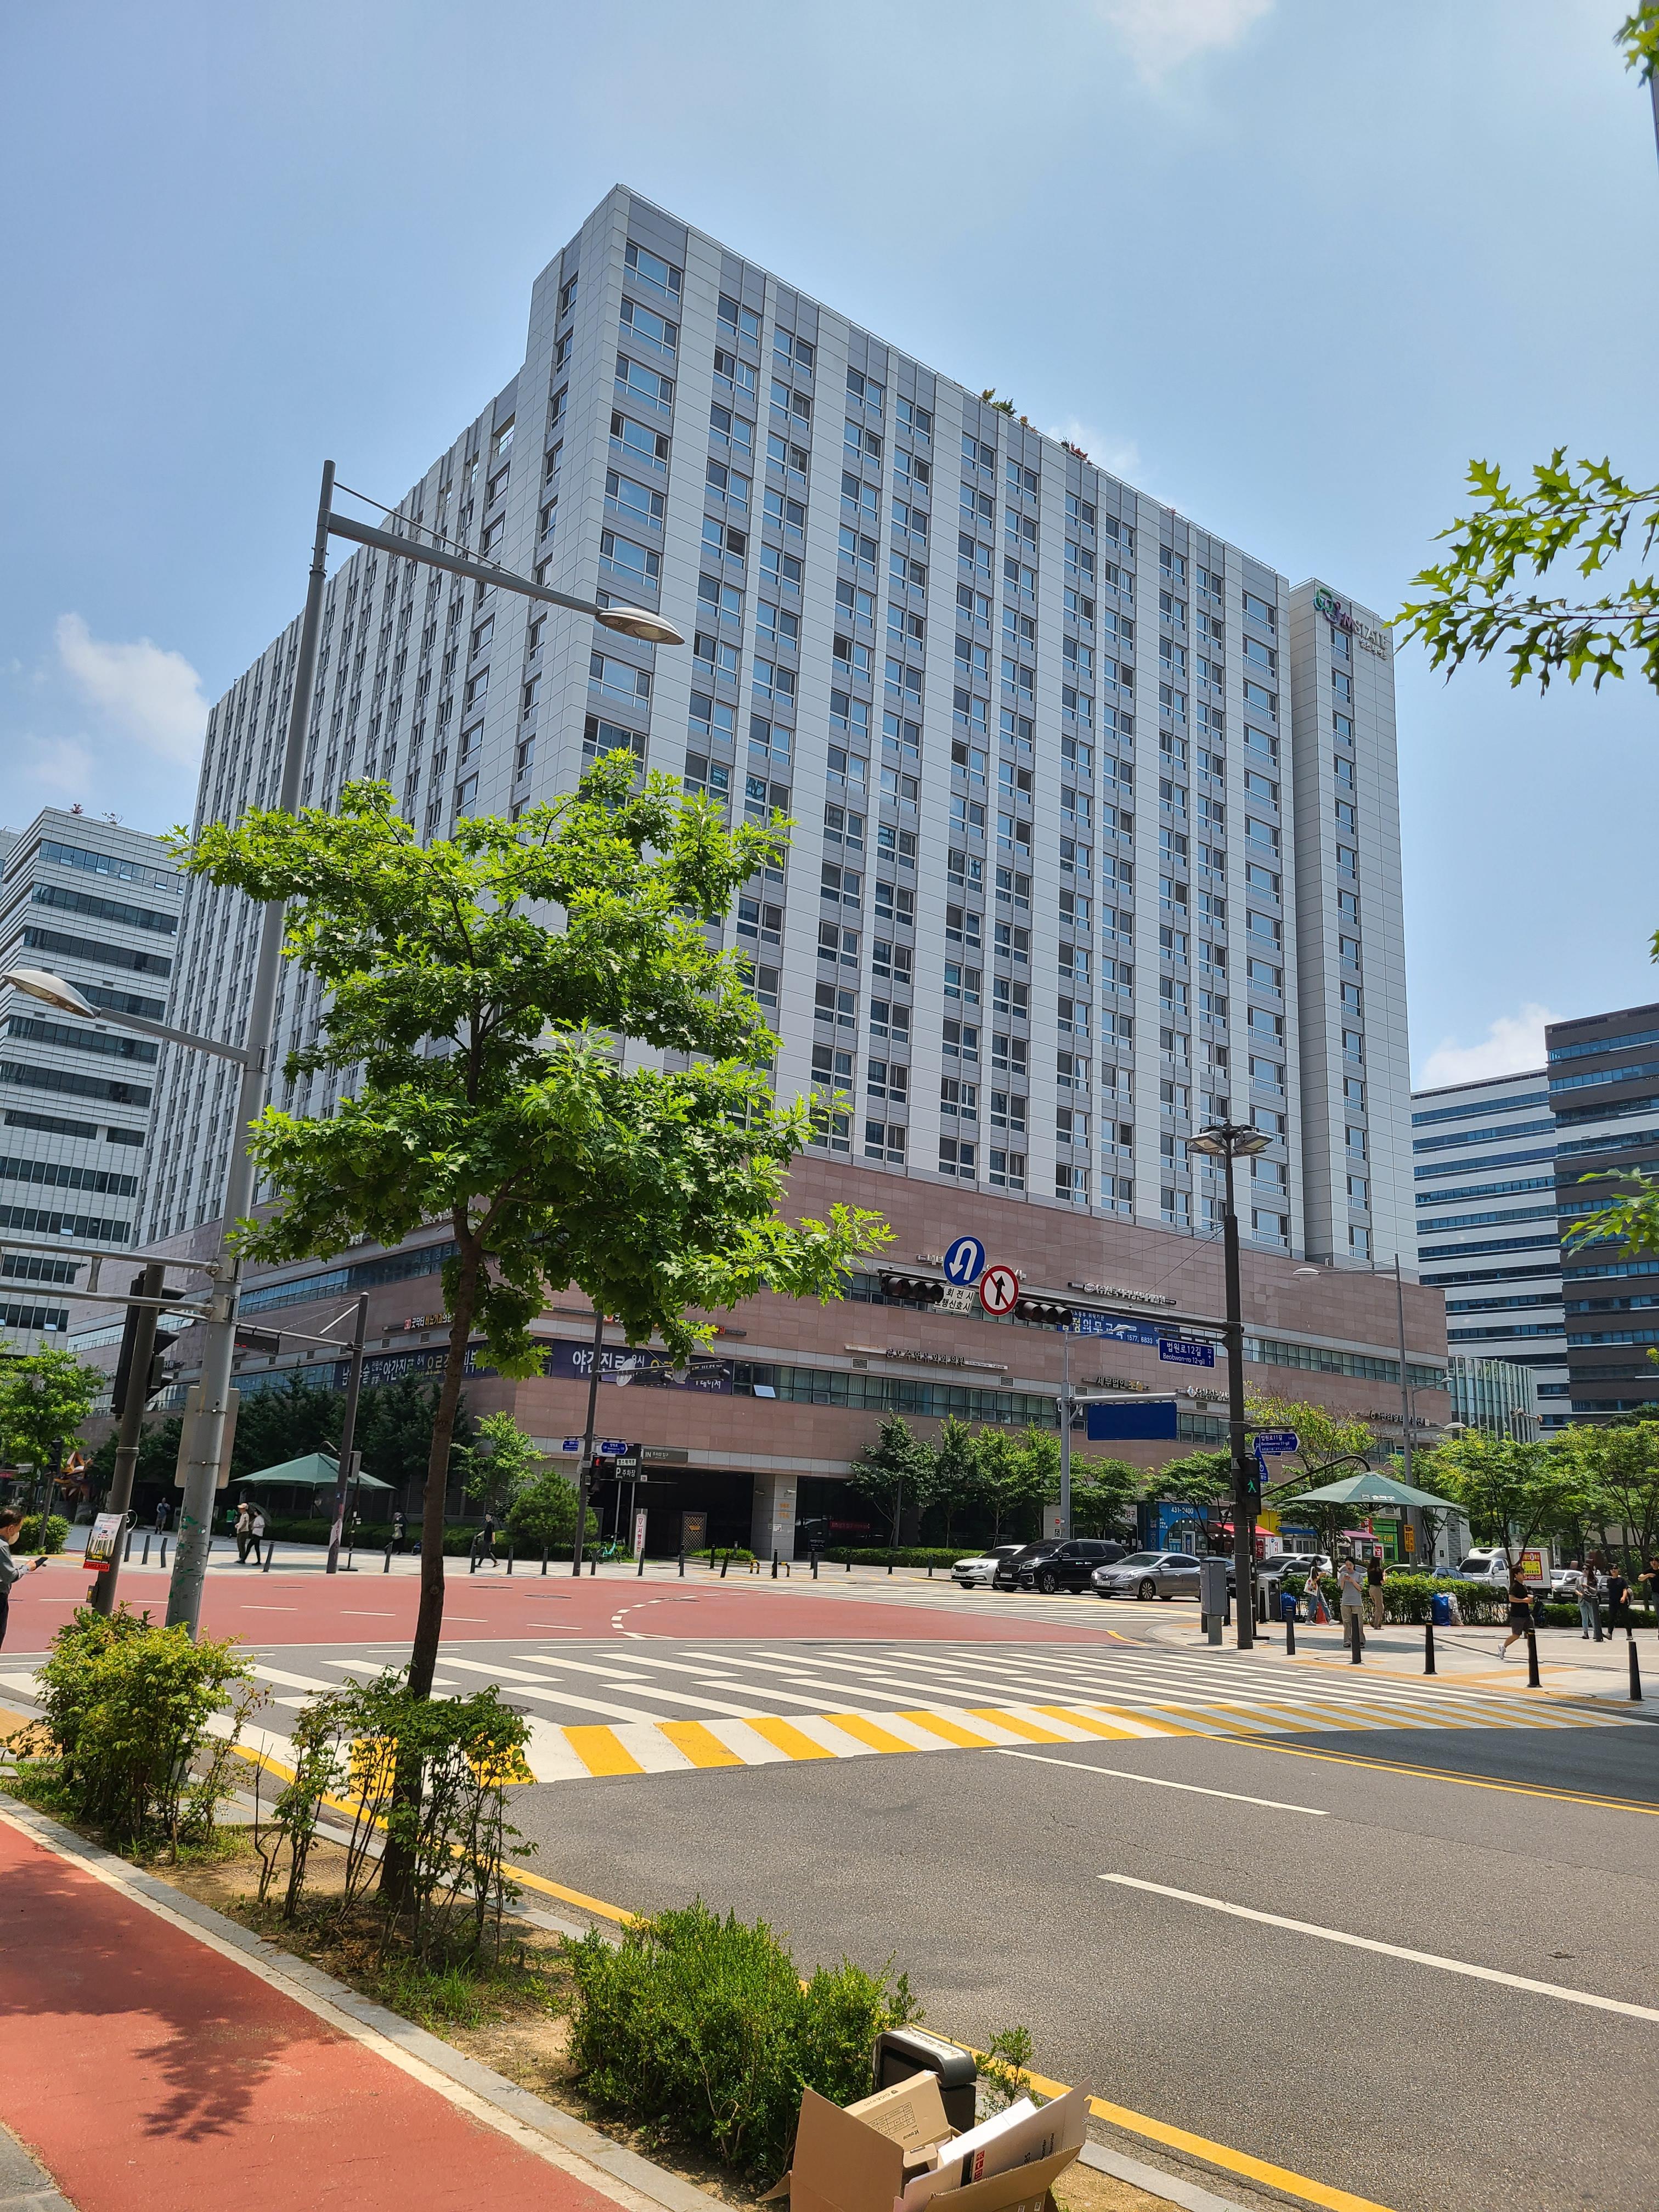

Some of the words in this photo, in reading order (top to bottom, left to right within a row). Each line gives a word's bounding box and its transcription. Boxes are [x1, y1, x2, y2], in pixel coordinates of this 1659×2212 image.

[1166, 1342, 1201, 1357] 법원로12길
[1163, 1353, 1191, 1363] Beobwon-ro
[1192, 1357, 1205, 1365] 12-gil
[1097, 1376, 1126, 1389] 세무법인
[622, 1469, 636, 1477] 주차장
